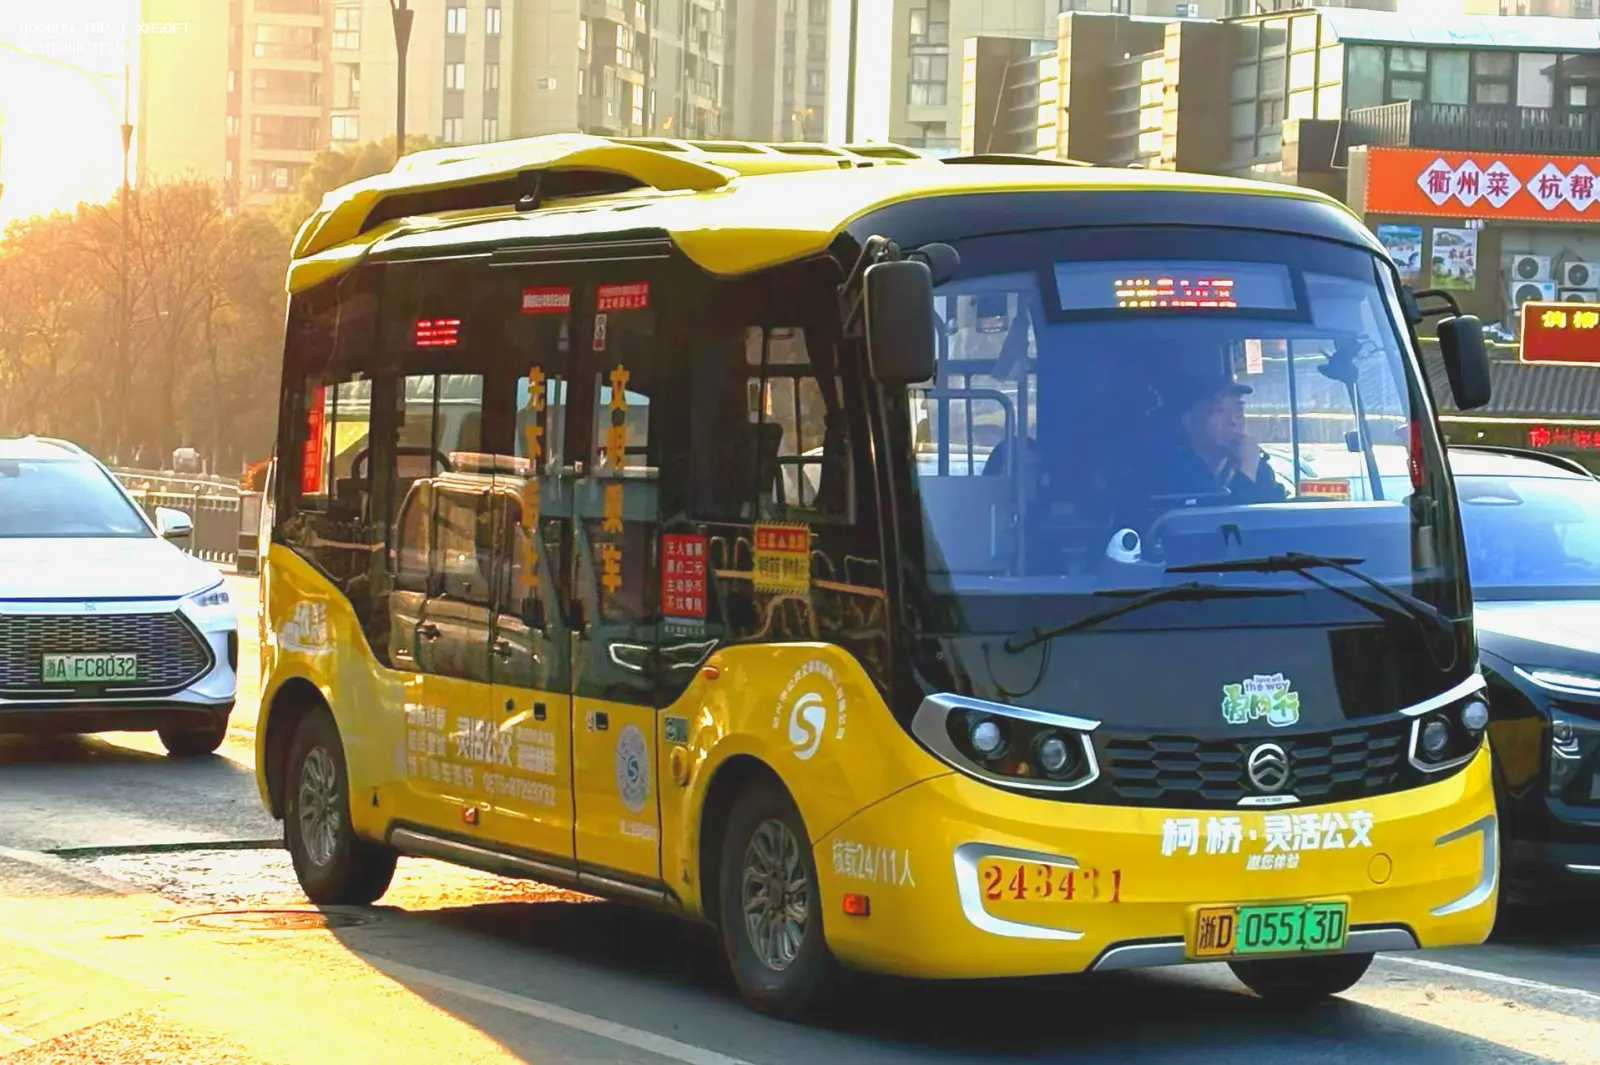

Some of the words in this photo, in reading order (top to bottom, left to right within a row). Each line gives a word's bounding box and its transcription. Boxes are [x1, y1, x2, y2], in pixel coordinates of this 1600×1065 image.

[1427, 169, 1510, 198] 衢州菜
[1538, 173, 1594, 200] 杭帮
[74, 656, 135, 678] FC8032
[1199, 914, 1234, 949] 浙D
[1245, 909, 1344, 948] 05513D
